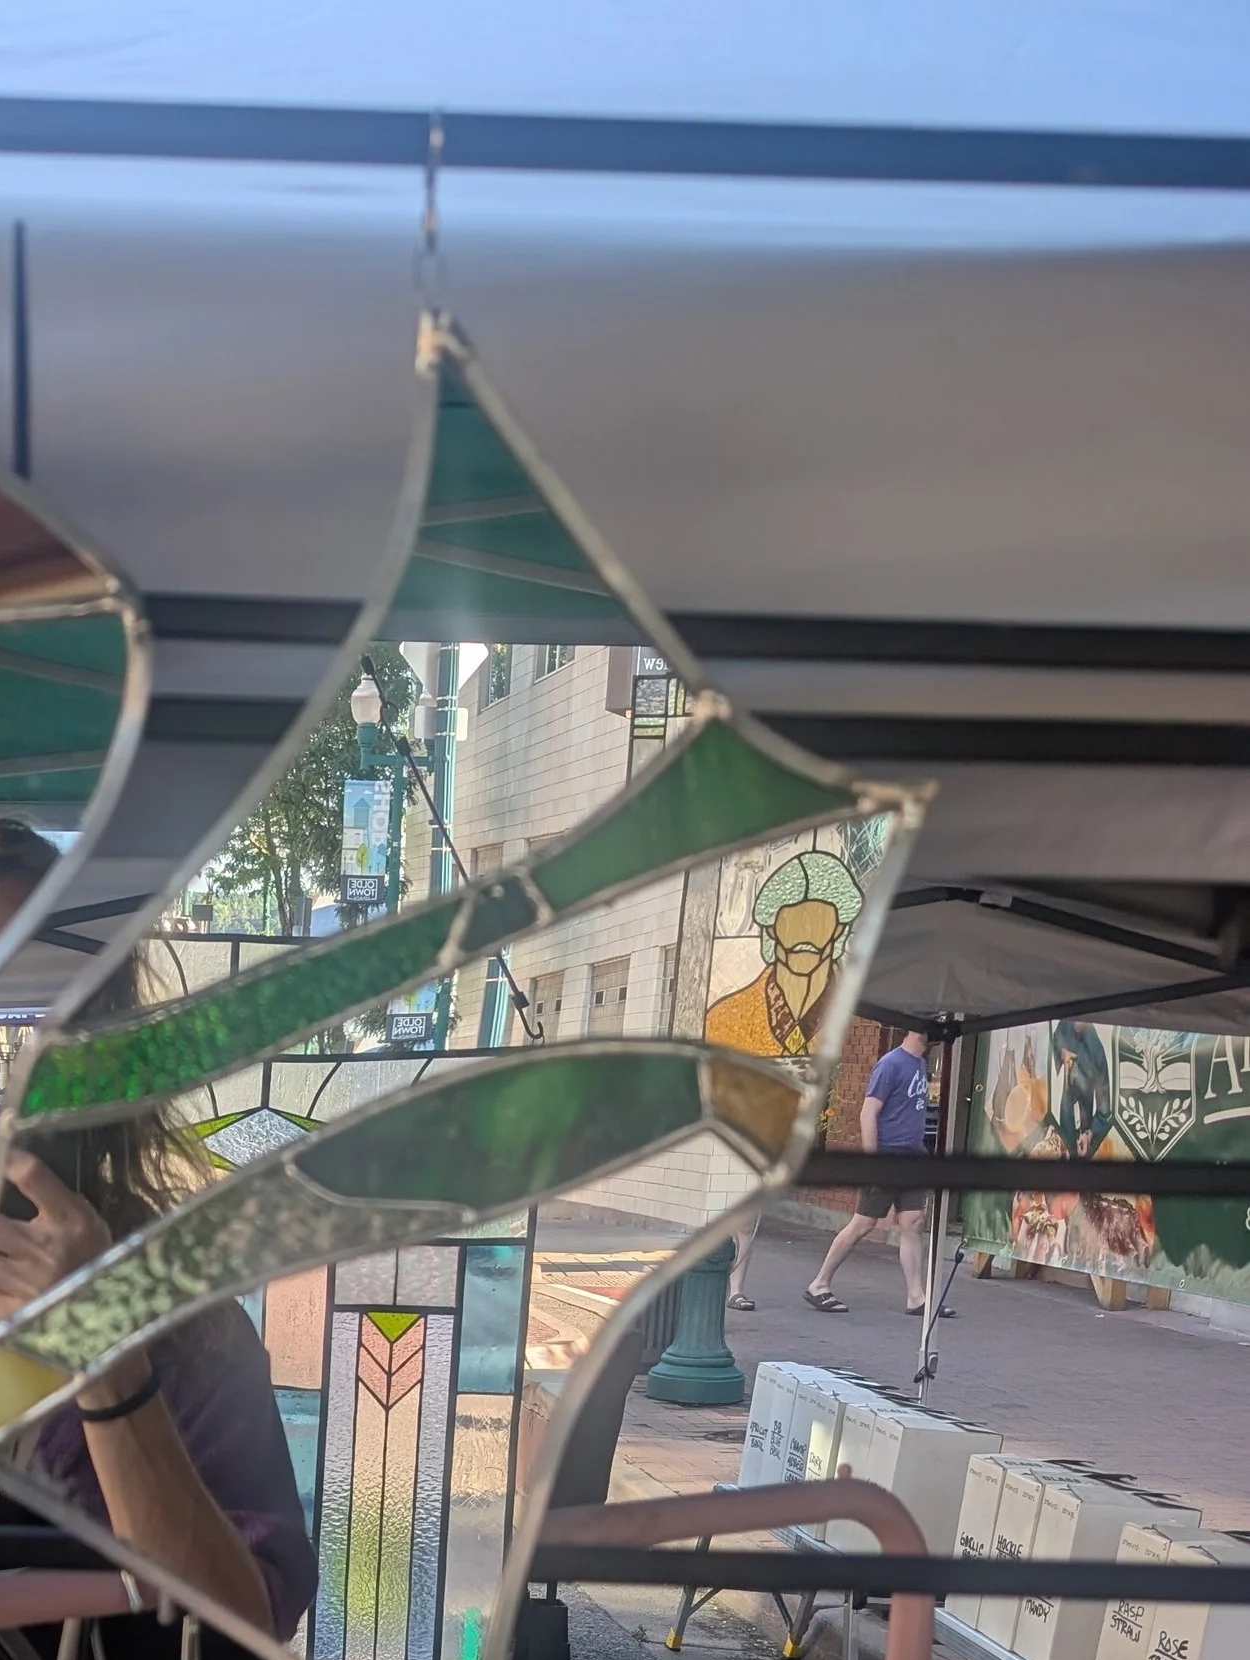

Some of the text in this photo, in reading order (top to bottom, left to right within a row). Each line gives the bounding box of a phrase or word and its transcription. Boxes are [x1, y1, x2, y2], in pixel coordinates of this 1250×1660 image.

[1042, 1475, 1082, 1484] GLASS
[959, 1531, 984, 1556] GARLIC
[1024, 1598, 1051, 1623] MANDY
[1117, 1599, 1145, 1622] RASP
[1110, 1614, 1142, 1644] STRAW
[1157, 1630, 1190, 1660] ROSE
